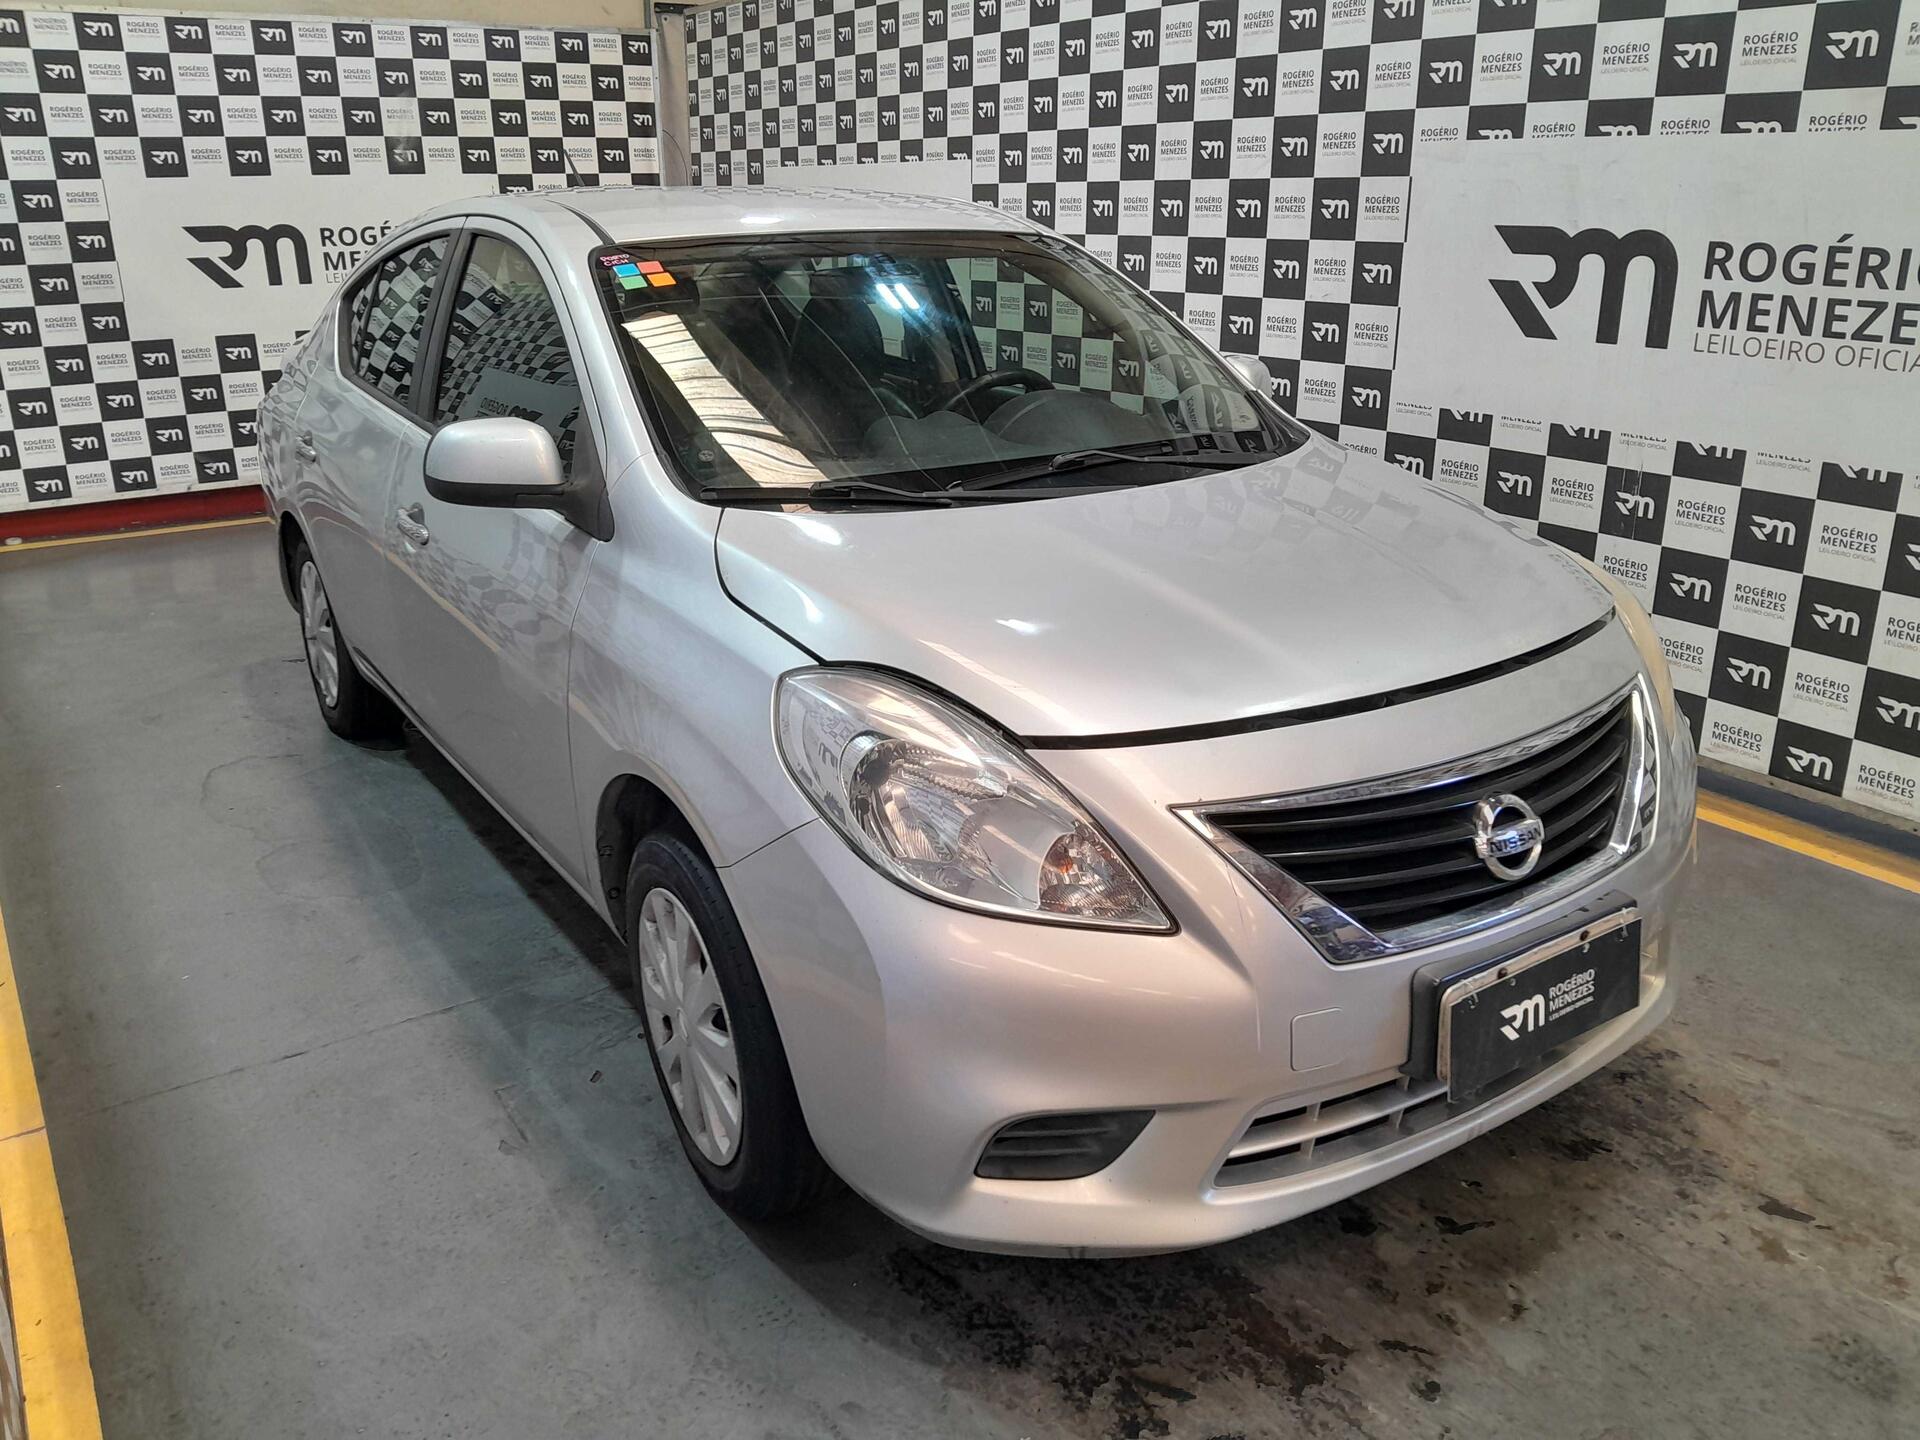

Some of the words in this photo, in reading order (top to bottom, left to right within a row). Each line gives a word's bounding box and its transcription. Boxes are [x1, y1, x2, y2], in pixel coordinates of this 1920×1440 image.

[1243, 9, 1274, 21] ROGÉRIO
[1243, 18, 1274, 29] MENEZES
[1743, 29, 1800, 44] ROGÉRIO
[1602, 41, 1650, 55] ROGÉRIO
[1741, 41, 1799, 56] MENEZES
[1481, 51, 1523, 64] ROGÉRIO
[1601, 53, 1650, 66] MENEZES
[1375, 60, 1411, 72] ROGÉRIO
[1480, 62, 1522, 74] MENEZES
[1282, 68, 1314, 80] ROGÉRIO
[1374, 70, 1411, 81] MENEZES
[1200, 76, 1228, 86] ROGÉRIO
[1281, 78, 1314, 88] MENEZES
[1200, 85, 1229, 95] MENEZES
[1659, 117, 1710, 130] ROGÉRIO
[1808, 112, 1868, 126] ROGÉRIO
[1420, 126, 1458, 137] ROGÉRIO
[1531, 121, 1575, 134] ROGÉRIO
[1236, 134, 1266, 144] ROGÉRIO
[1322, 130, 1356, 141] ROGÉRIO
[1236, 143, 1266, 152] MENEZES
[1322, 140, 1356, 149] MENEZES
[1194, 194, 1222, 204] ROGÉRIO
[1274, 194, 1305, 204] ROGÉRIO
[1364, 194, 1400, 204] ROGÉRIO
[1194, 204, 1222, 212] MENEZES
[1274, 204, 1305, 213] MENEZES
[1363, 205, 1399, 214] MENEZES
[1229, 253, 1259, 263] ROGÉRIO
[1313, 257, 1346, 267] ROGÉRIO
[1704, 233, 1920, 291] ROGÉRI
[1229, 263, 1259, 272] MENEZES
[1313, 266, 1346, 276] MENEZES
[1266, 315, 1297, 325] ROGÉRIO
[1265, 323, 1296, 333] MENEZES
[1354, 322, 1388, 333] ROGÉRIO
[1353, 331, 1388, 342] MENEZES
[1694, 333, 1825, 363] LEILOEIRO
[1304, 378, 1336, 389] ROGÉRIO
[1304, 386, 1336, 397] MENEZES
[1441, 458, 1479, 472] ROGÉRIO
[1440, 467, 1478, 481] MENEZES
[1551, 477, 1594, 492] ROGÉRIO
[1550, 486, 1593, 502] MENEZES
[1676, 498, 1726, 515] ROGÉRIO
[1675, 508, 1725, 526] MENEZES
[1821, 524, 1878, 543] ROGÉRIO
[1819, 534, 1877, 554] MENEZES
[1602, 555, 1648, 573] ROGÉRIO
[1601, 564, 1647, 582] MENEZES
[1734, 583, 1787, 602] ROGÉRIO
[1733, 592, 1786, 613] MENEZES
[1795, 671, 1850, 693] ROGÉRIO
[1793, 681, 1849, 704] MENEZES
[1712, 721, 1762, 743] ROGÉRIO
[1710, 730, 1761, 753] MENEZES
[1859, 764, 1919, 790] ROGÉRIO
[1857, 774, 1917, 801] MENEZES
[1549, 969, 1595, 999] ROGÉRIO
[1549, 981, 1595, 1012] MENEZES
